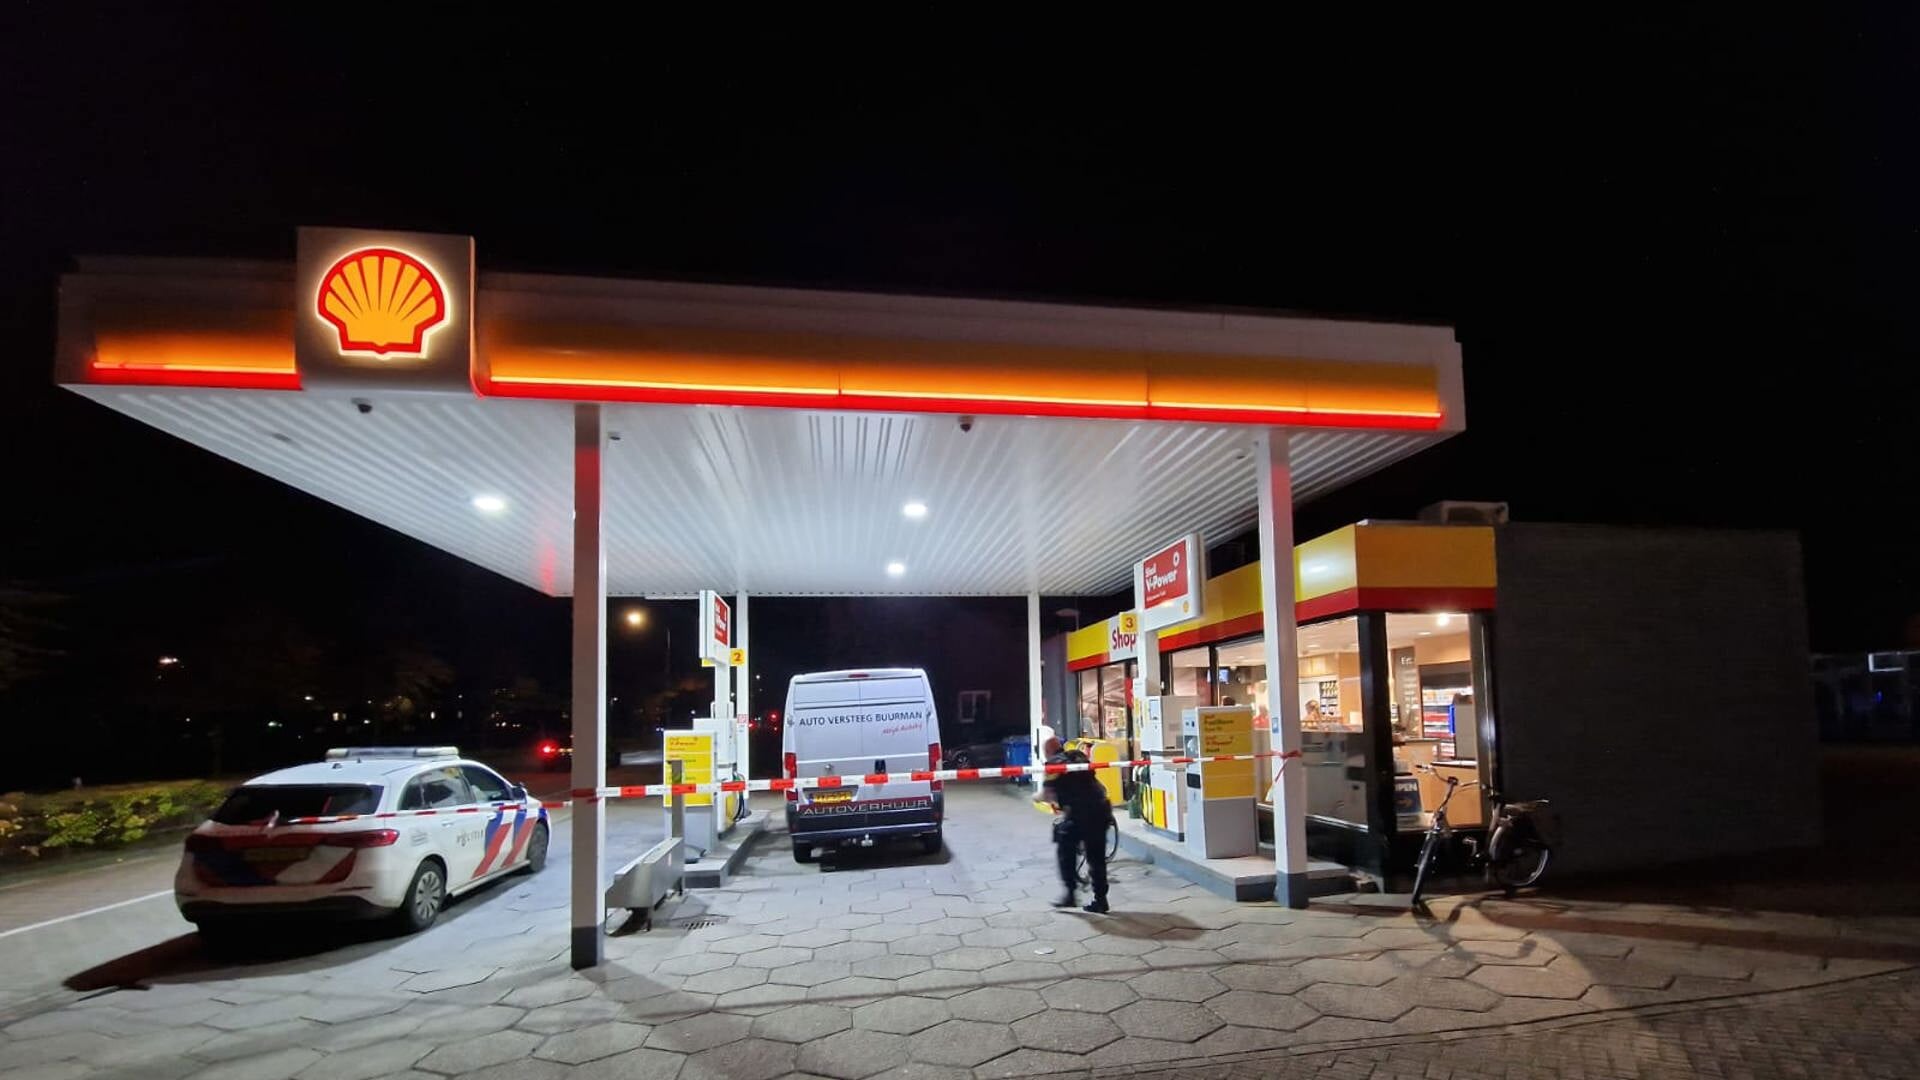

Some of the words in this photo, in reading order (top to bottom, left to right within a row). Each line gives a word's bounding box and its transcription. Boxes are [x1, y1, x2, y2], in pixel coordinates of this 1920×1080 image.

[1146, 569, 1178, 592] V-Power
[1125, 617, 1133, 628] 3
[1112, 626, 1136, 651] Shop
[734, 652, 741, 661] 2
[799, 717, 825, 727] AUTO
[828, 713, 873, 724] VERSTEEG
[875, 711, 923, 722] BUURMAN
[803, 800, 928, 816] AUTOVERHUUR
